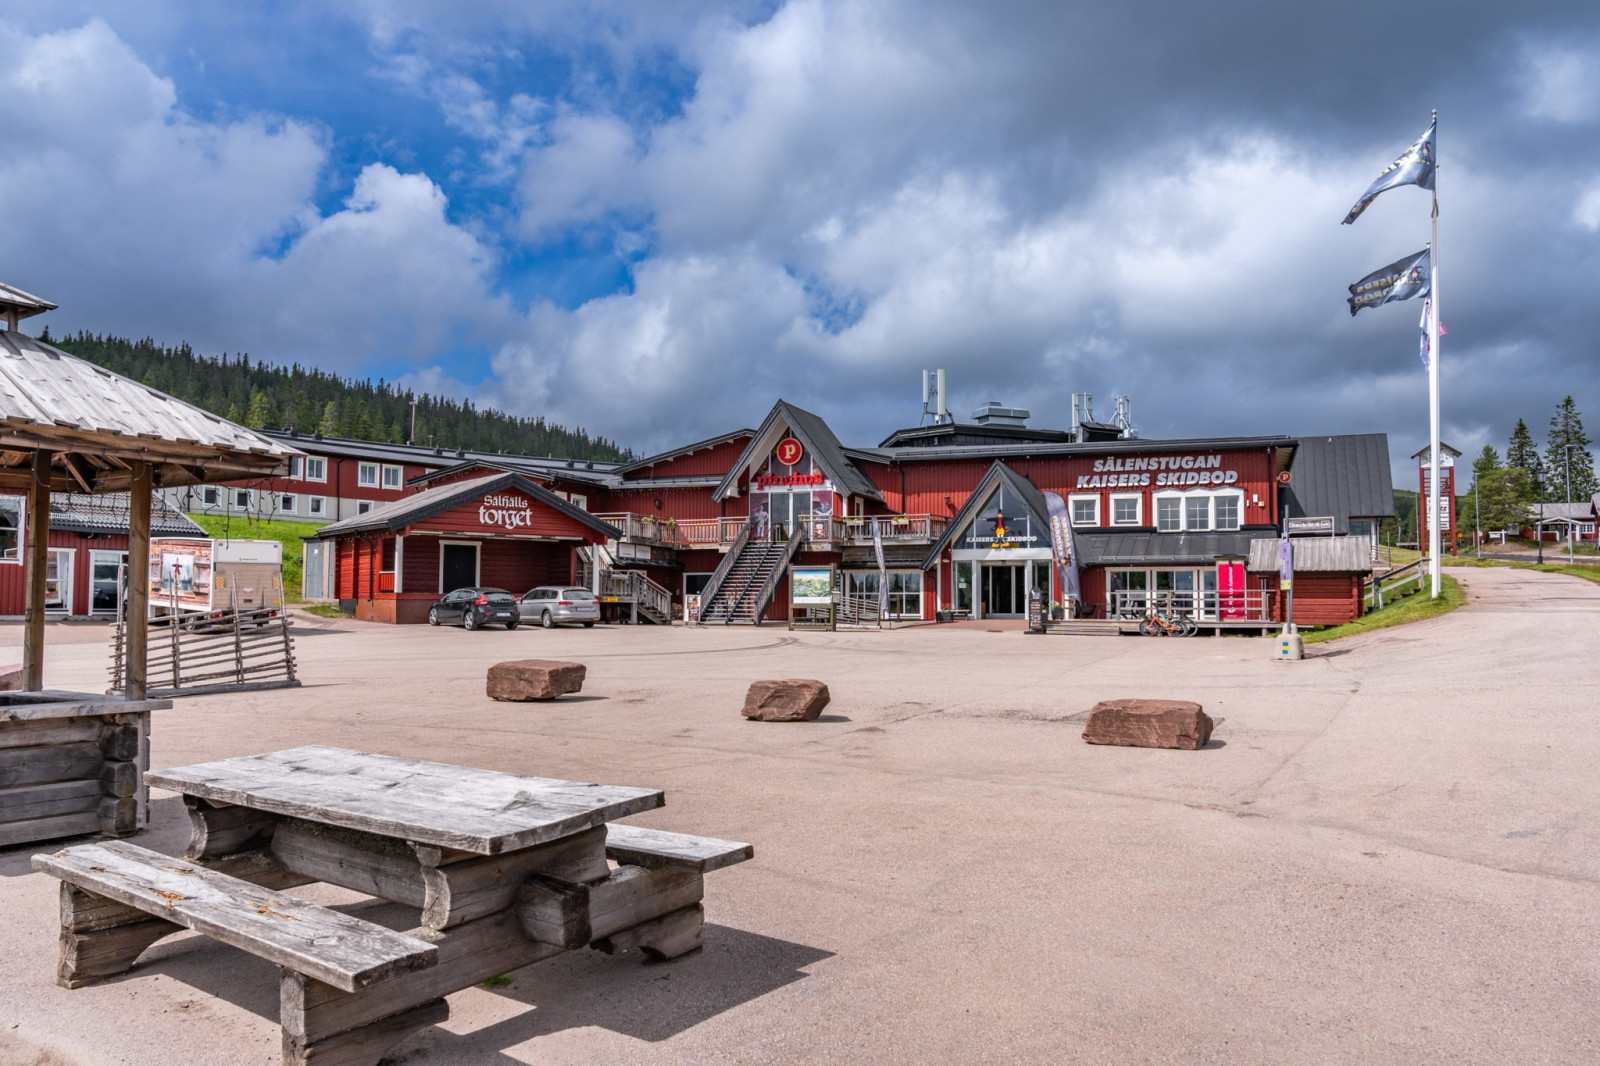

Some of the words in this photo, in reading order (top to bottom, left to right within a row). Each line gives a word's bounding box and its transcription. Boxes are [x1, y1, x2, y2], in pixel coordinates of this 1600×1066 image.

[1093, 455, 1221, 472] SÄLENSTUGAN
[757, 471, 824, 490] pinchos
[1077, 473, 1150, 488] KAISERS
[1156, 470, 1238, 486] SKIDBOD
[478, 505, 533, 530] torget
